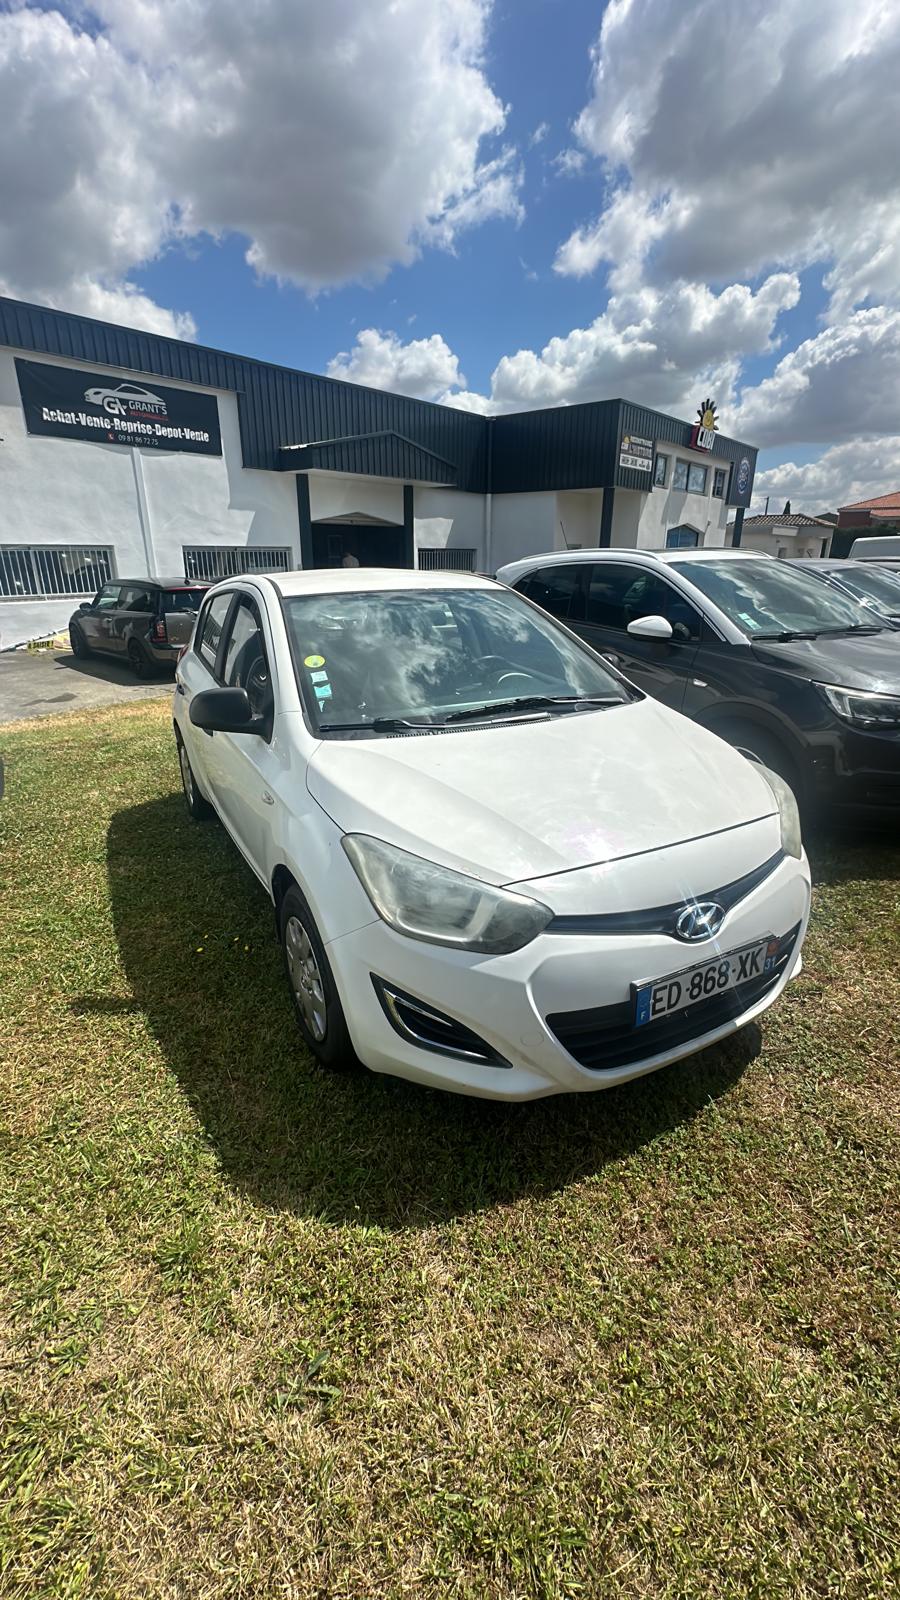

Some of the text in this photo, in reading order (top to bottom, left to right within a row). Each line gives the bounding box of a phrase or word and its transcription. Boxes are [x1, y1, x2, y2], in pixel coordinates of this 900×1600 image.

[128, 400, 168, 415] GRANT'S
[42, 407, 210, 443] Achat-Vente-Reprise-Depot-Vente
[143, 437, 151, 445] 72
[764, 956, 776, 970] 31
[651, 947, 764, 1016] ED-868-XK
[640, 1011, 646, 1021] F
